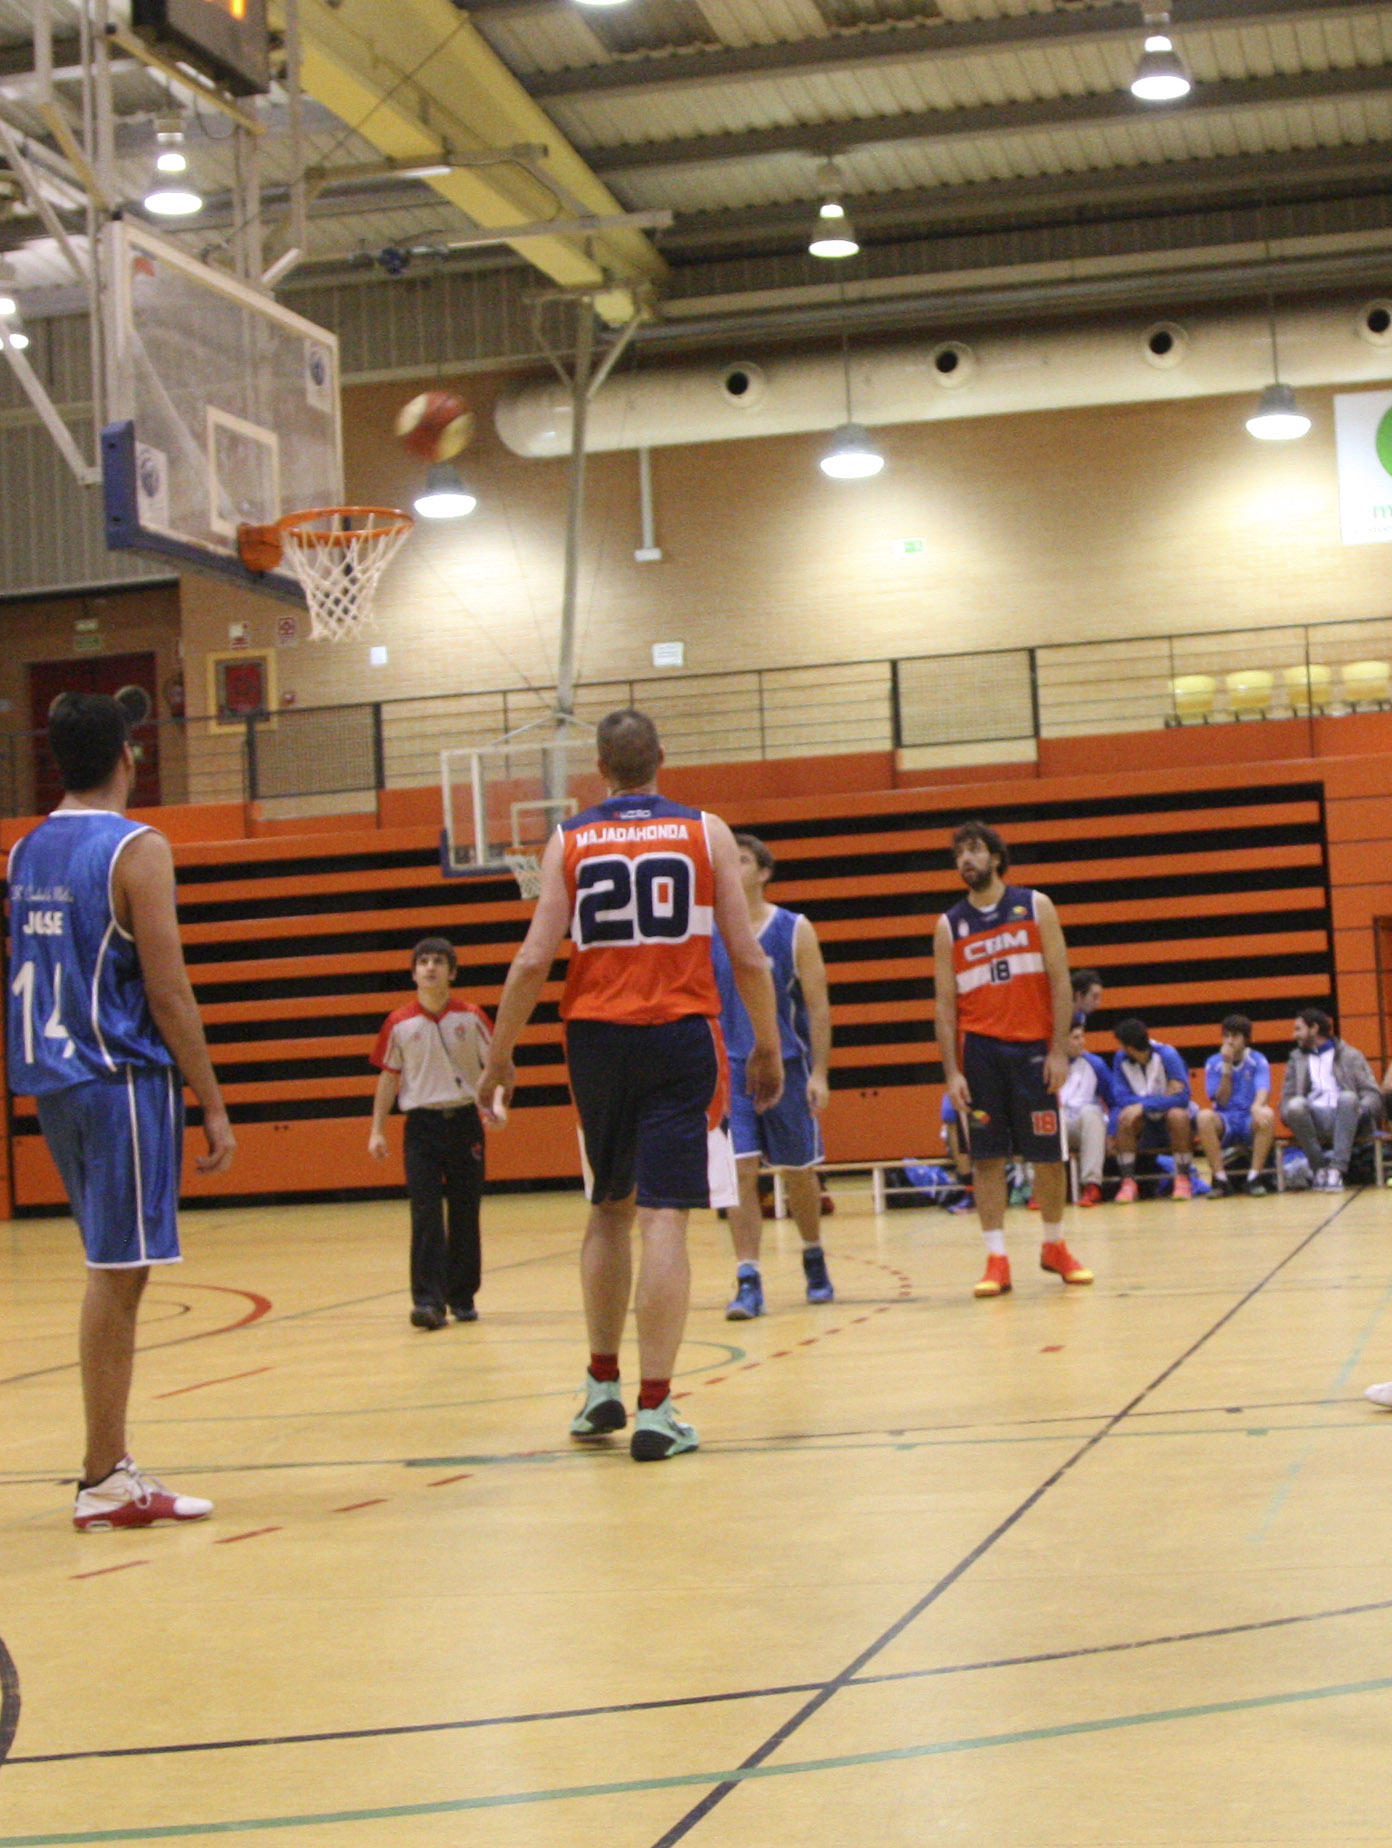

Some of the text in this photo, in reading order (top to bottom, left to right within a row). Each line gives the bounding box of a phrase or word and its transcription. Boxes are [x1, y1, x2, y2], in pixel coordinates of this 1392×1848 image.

[576, 824, 689, 848] MAJADAHONDA
[575, 852, 697, 952] 20
[963, 929, 1028, 963] CBM
[990, 959, 1011, 983] 18
[12, 961, 76, 1064] 14
[1031, 1110, 1058, 1136] 18
